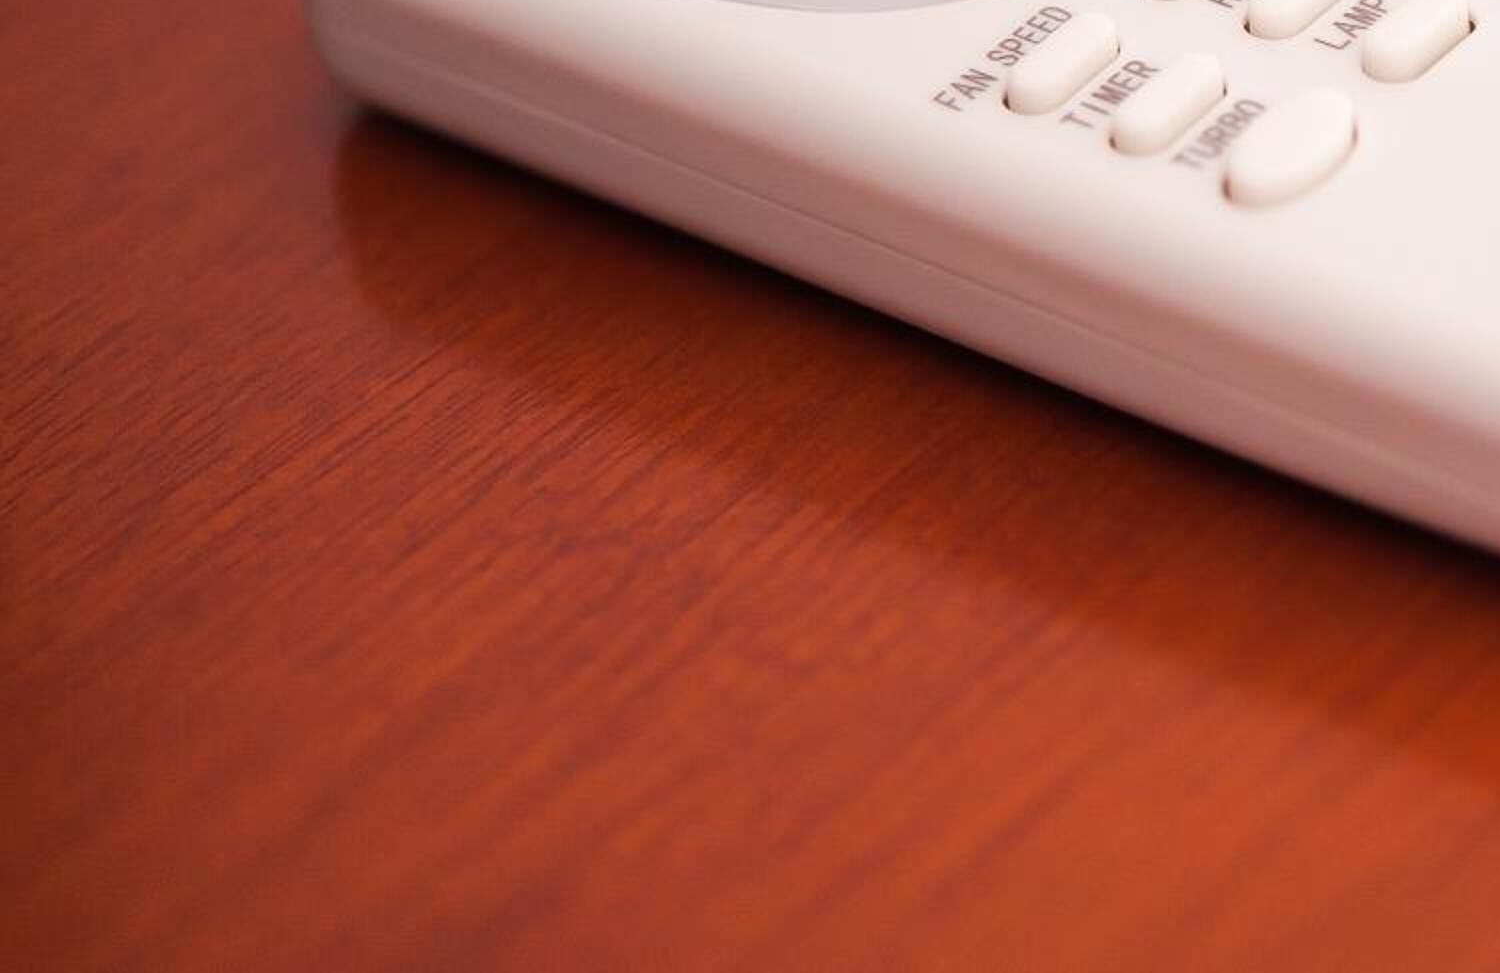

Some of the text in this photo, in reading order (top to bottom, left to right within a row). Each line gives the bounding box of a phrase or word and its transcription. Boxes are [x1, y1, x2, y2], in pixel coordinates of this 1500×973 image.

[933, 6, 1073, 112] FAN SPEED
[1059, 60, 1161, 128] TIMER
[1171, 98, 1266, 170] TURBO
